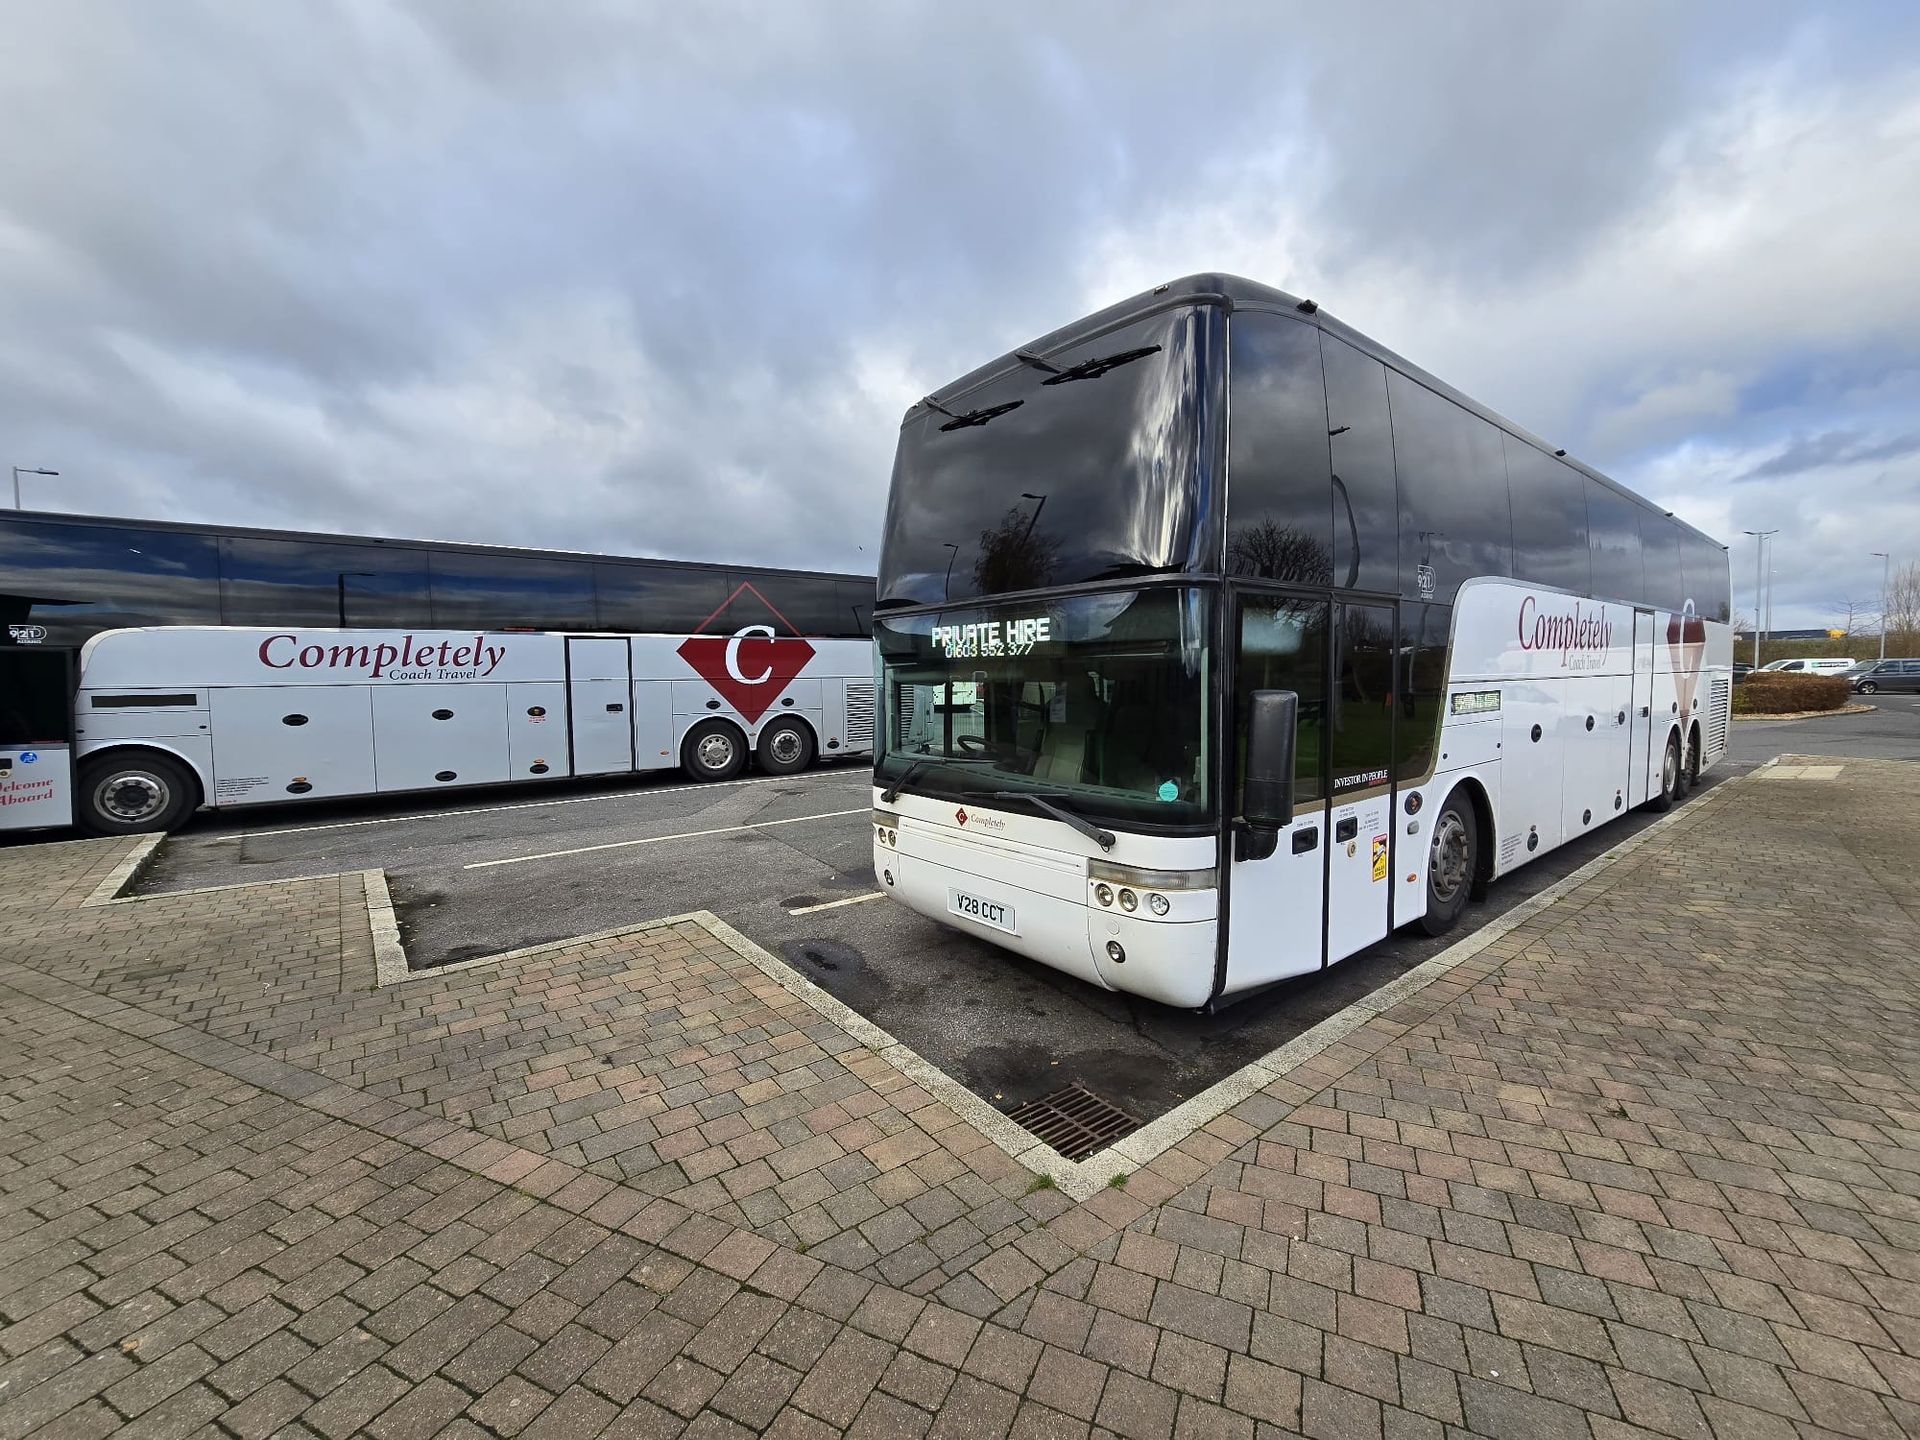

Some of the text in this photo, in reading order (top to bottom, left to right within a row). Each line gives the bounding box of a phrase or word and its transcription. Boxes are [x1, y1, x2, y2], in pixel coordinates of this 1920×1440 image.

[9, 630, 35, 638] 921
[931, 617, 1051, 648] PRIVATE HIRE
[1518, 595, 1612, 667] Completely
[258, 634, 506, 678] Completely
[724, 625, 776, 685] C
[945, 639, 1034, 658] 01603 552 377
[389, 668, 477, 680] Coach Travel
[1334, 774, 1361, 789] INVESTOR
[1361, 773, 1369, 783] IN
[1368, 769, 1388, 781] PEOPLE
[970, 813, 1006, 831] Completely
[957, 893, 1005, 923] V28 CCT
